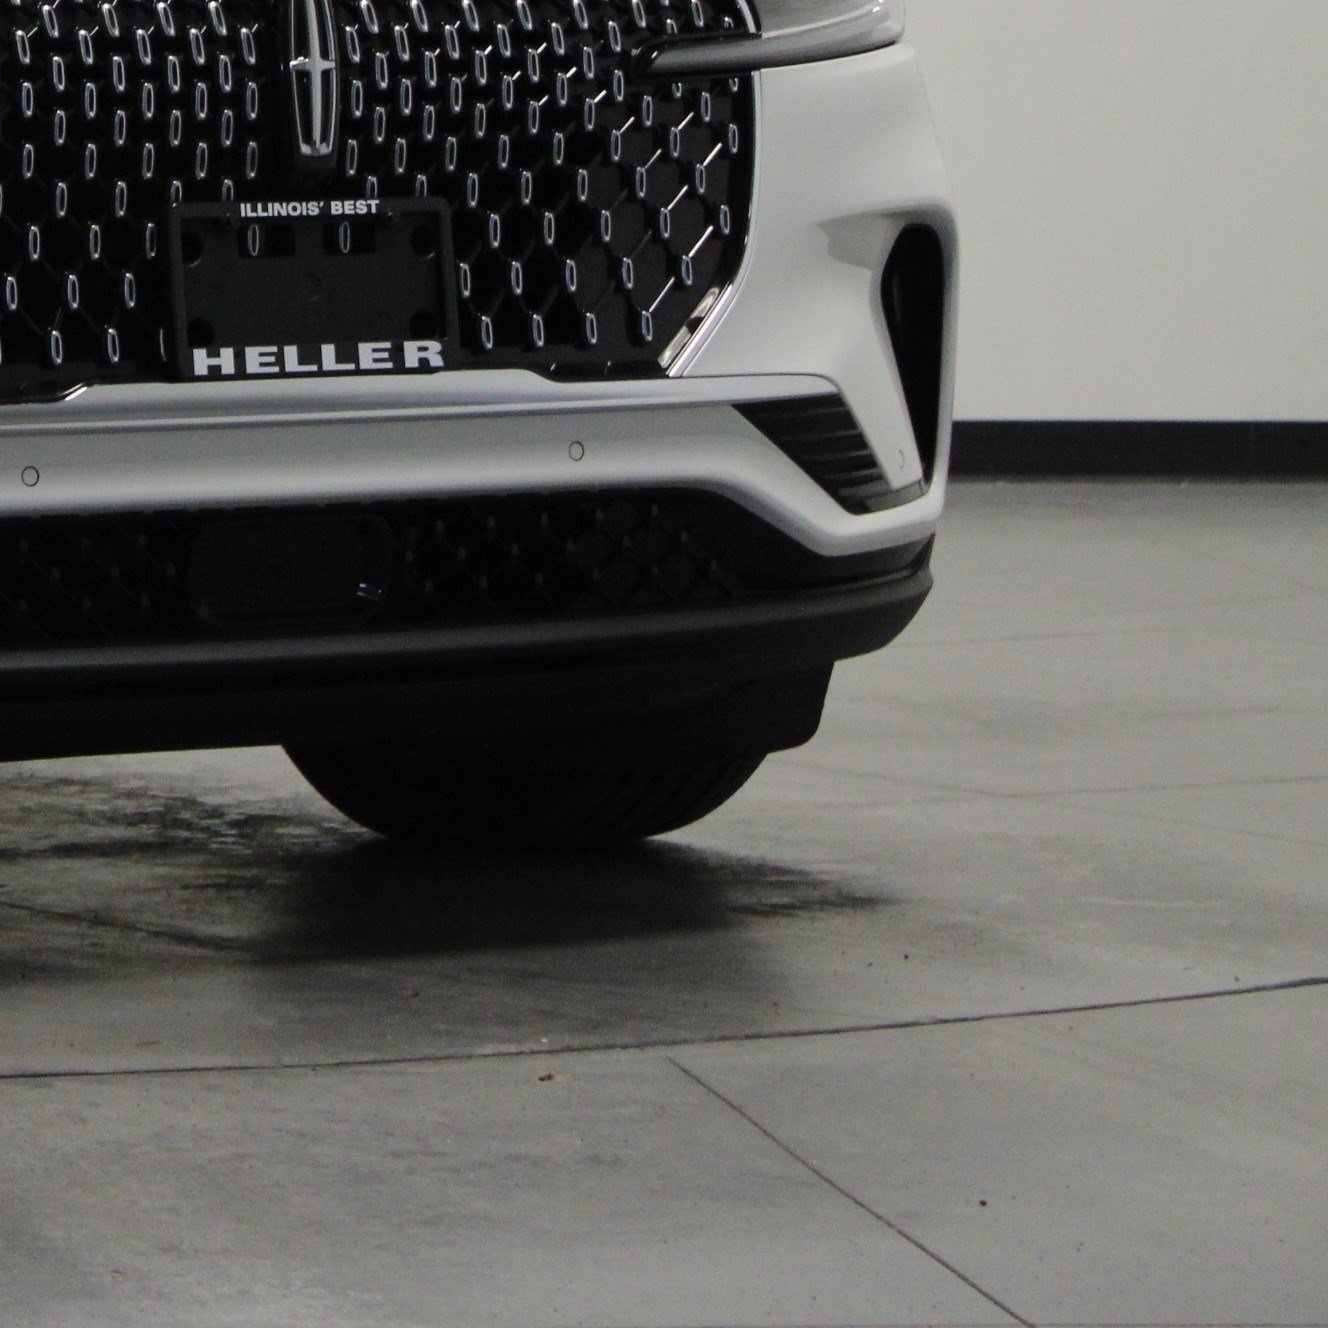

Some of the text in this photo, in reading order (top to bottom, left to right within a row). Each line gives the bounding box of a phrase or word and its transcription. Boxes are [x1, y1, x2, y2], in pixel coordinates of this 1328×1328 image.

[241, 199, 380, 218] ILLINOIS' BEST
[193, 340, 444, 376] HELLER
